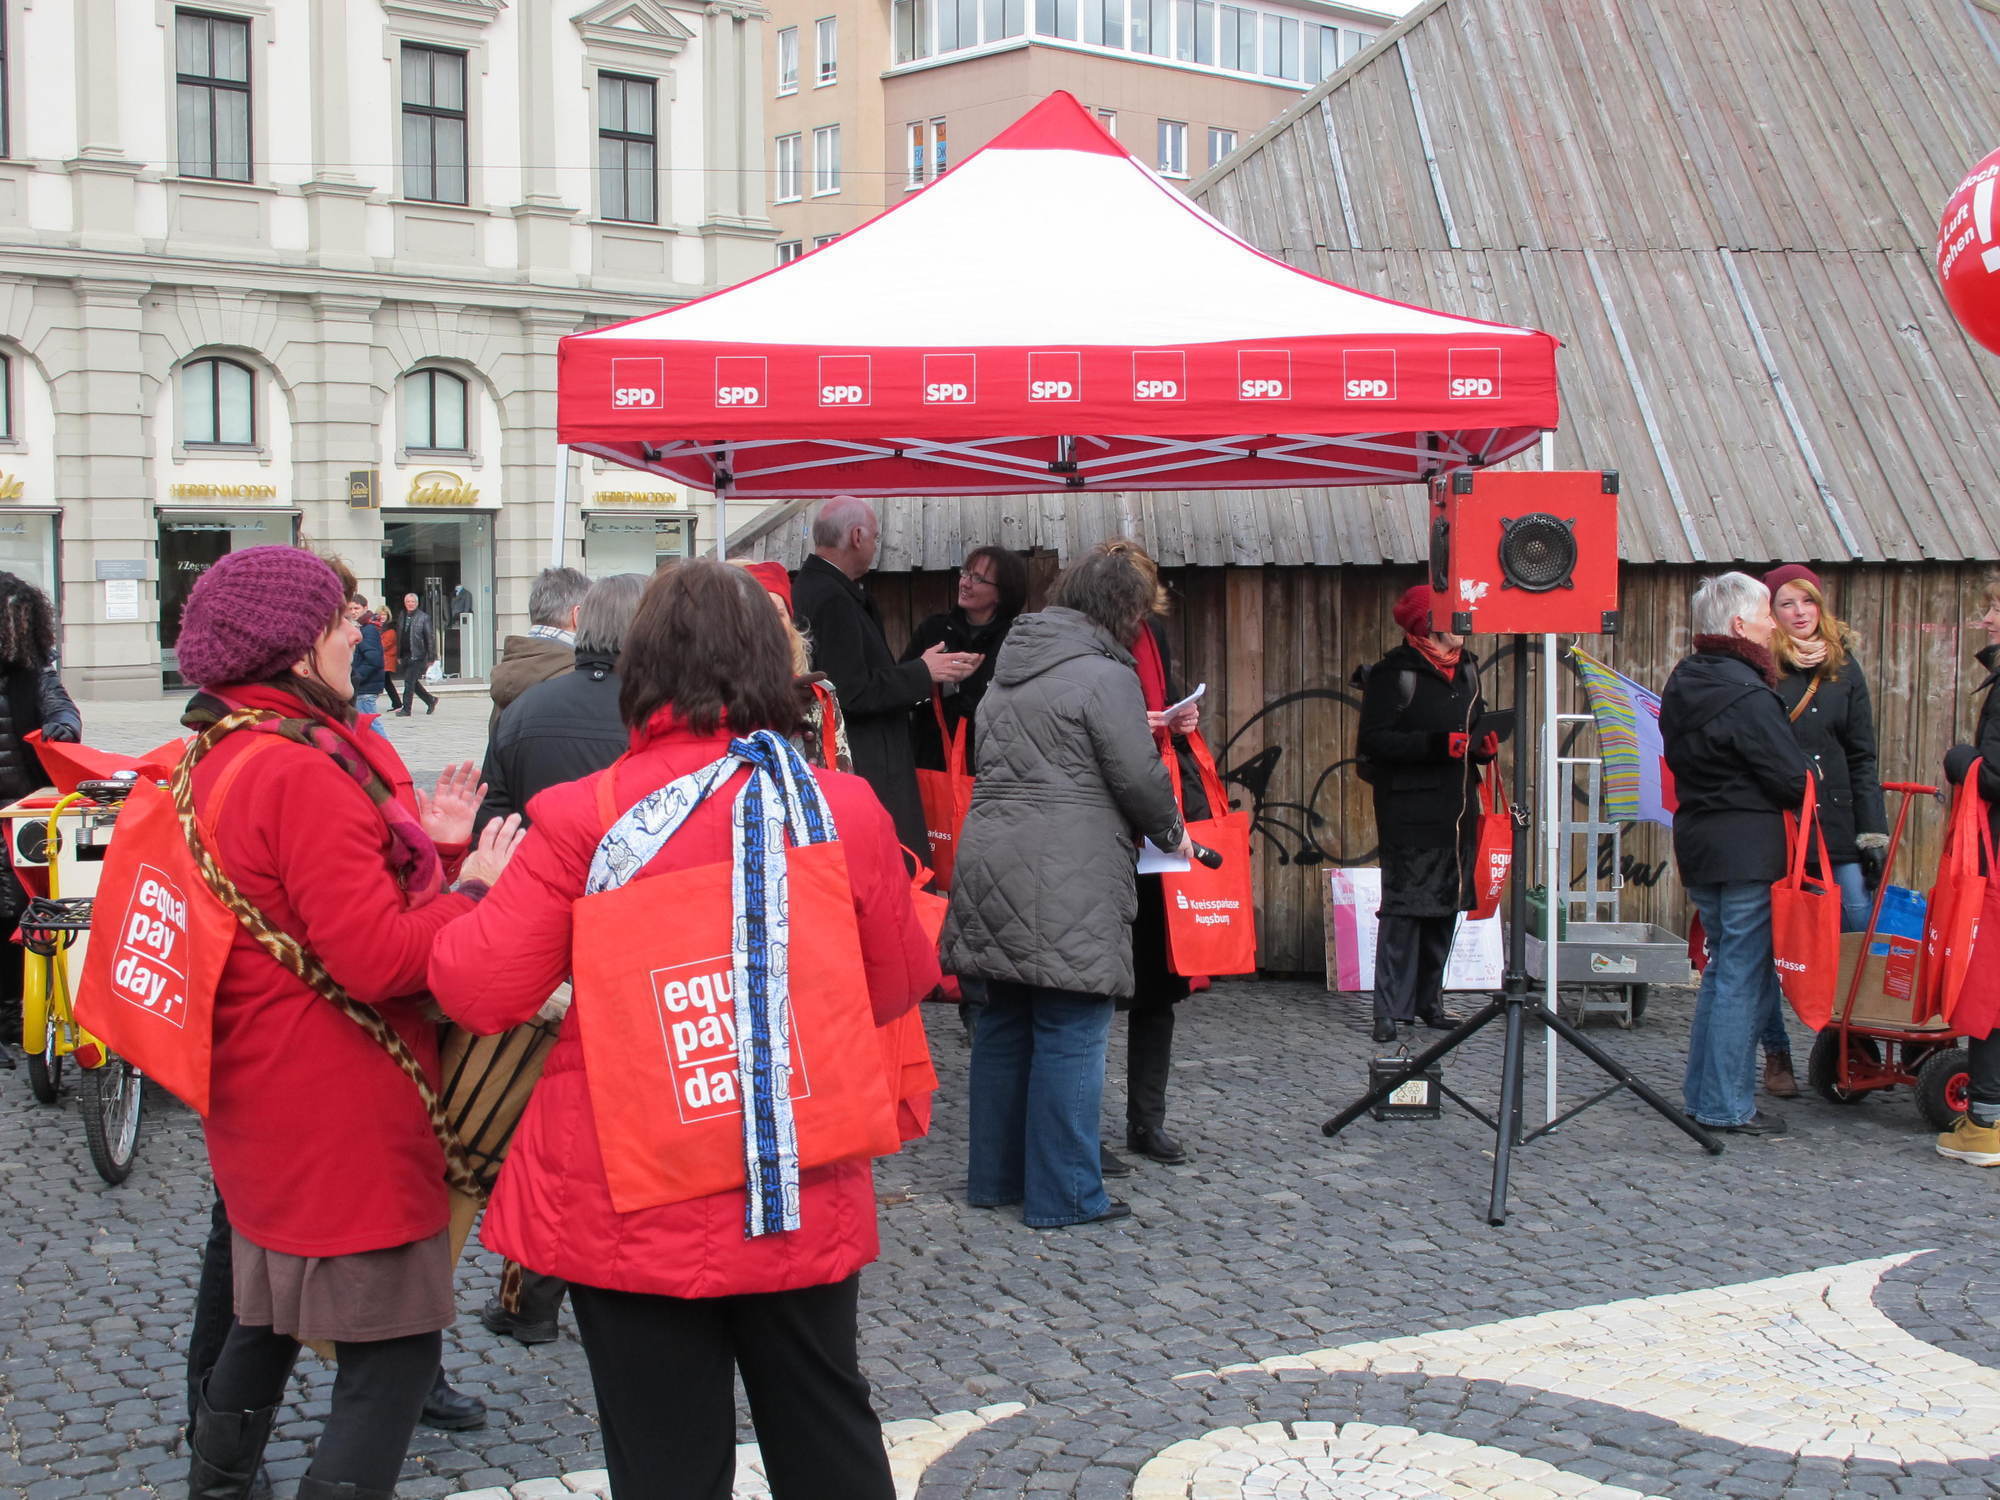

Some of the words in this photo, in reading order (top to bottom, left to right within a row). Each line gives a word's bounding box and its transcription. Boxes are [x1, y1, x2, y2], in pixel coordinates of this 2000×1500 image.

[1944, 203, 1969, 243] Luft
[1942, 227, 1975, 281] gehen
[719, 387, 758, 404] SPD
[822, 386, 862, 403] SPD
[927, 384, 967, 401] SPD
[1032, 381, 1072, 398] SPD
[1136, 381, 1177, 398] SPD
[1242, 380, 1282, 397] SPD
[1347, 380, 1388, 397] SPD
[1452, 379, 1492, 396] SPD
[616, 389, 655, 405] SPD
[171, 484, 276, 498] HERRENMODEN
[1491, 853, 1512, 866] equ
[139, 879, 186, 933] equal
[1195, 913, 1230, 926] Augsburg
[126, 912, 175, 960] pay
[663, 969, 735, 1014] equ
